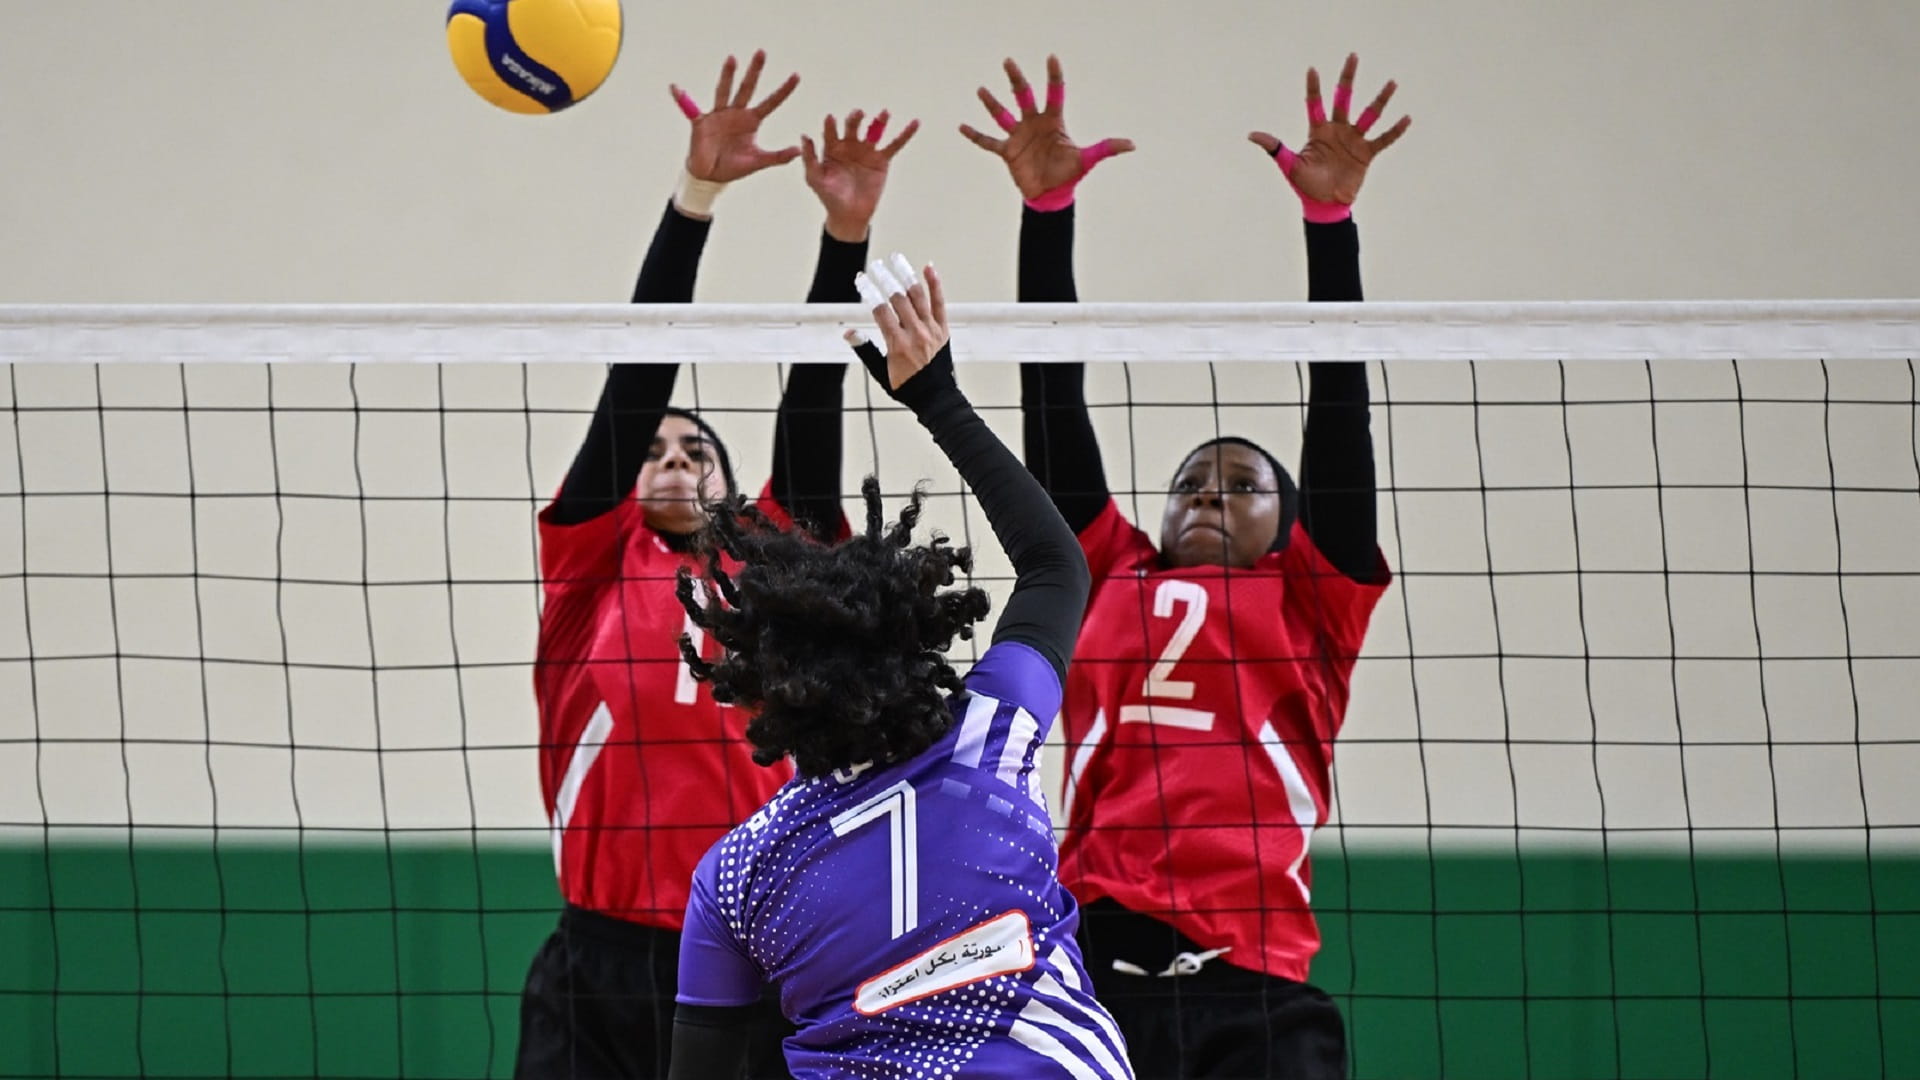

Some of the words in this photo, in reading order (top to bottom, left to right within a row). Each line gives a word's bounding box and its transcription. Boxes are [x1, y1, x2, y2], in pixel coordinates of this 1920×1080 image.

[1142, 579, 1209, 700] 2
[829, 779, 917, 940] 7
[925, 951, 958, 976] بكل
